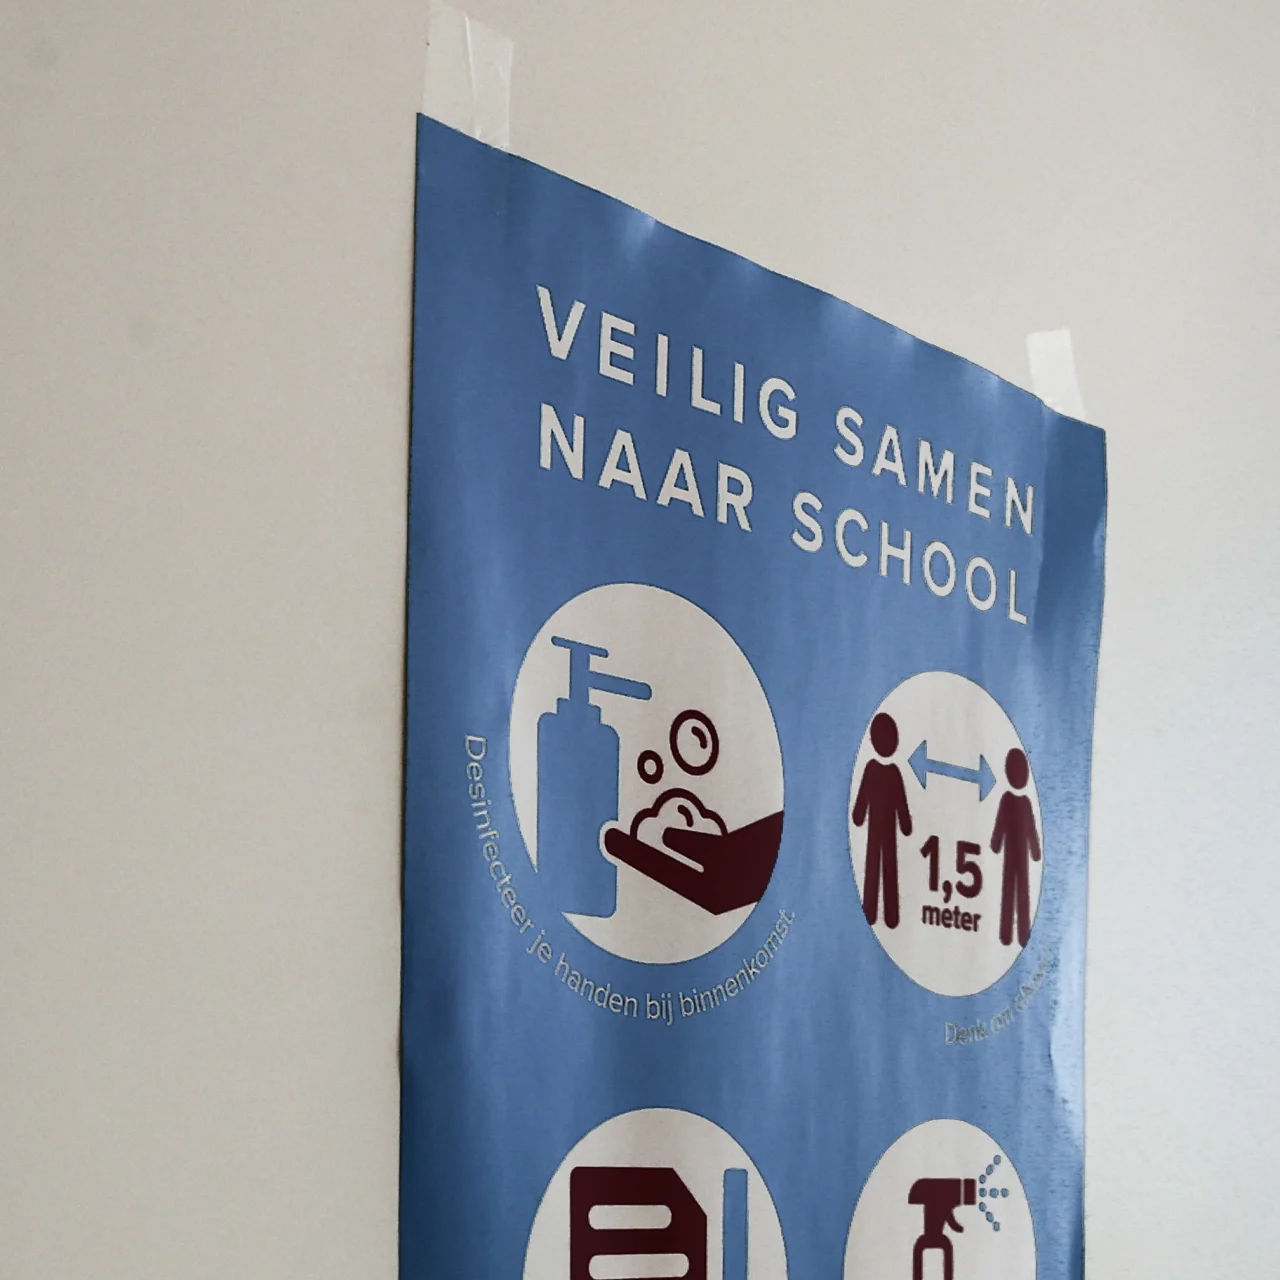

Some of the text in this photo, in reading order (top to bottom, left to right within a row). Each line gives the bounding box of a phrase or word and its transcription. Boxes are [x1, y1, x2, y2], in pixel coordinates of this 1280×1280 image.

[535, 284, 1035, 536] VEILIG SAMEN
[538, 401, 1029, 627] NAAR SCHOOL
[464, 734, 796, 1026] Desinfecteer je handen bij binnenkomst.
[919, 835, 983, 903] 1,5
[921, 904, 982, 932] meter
